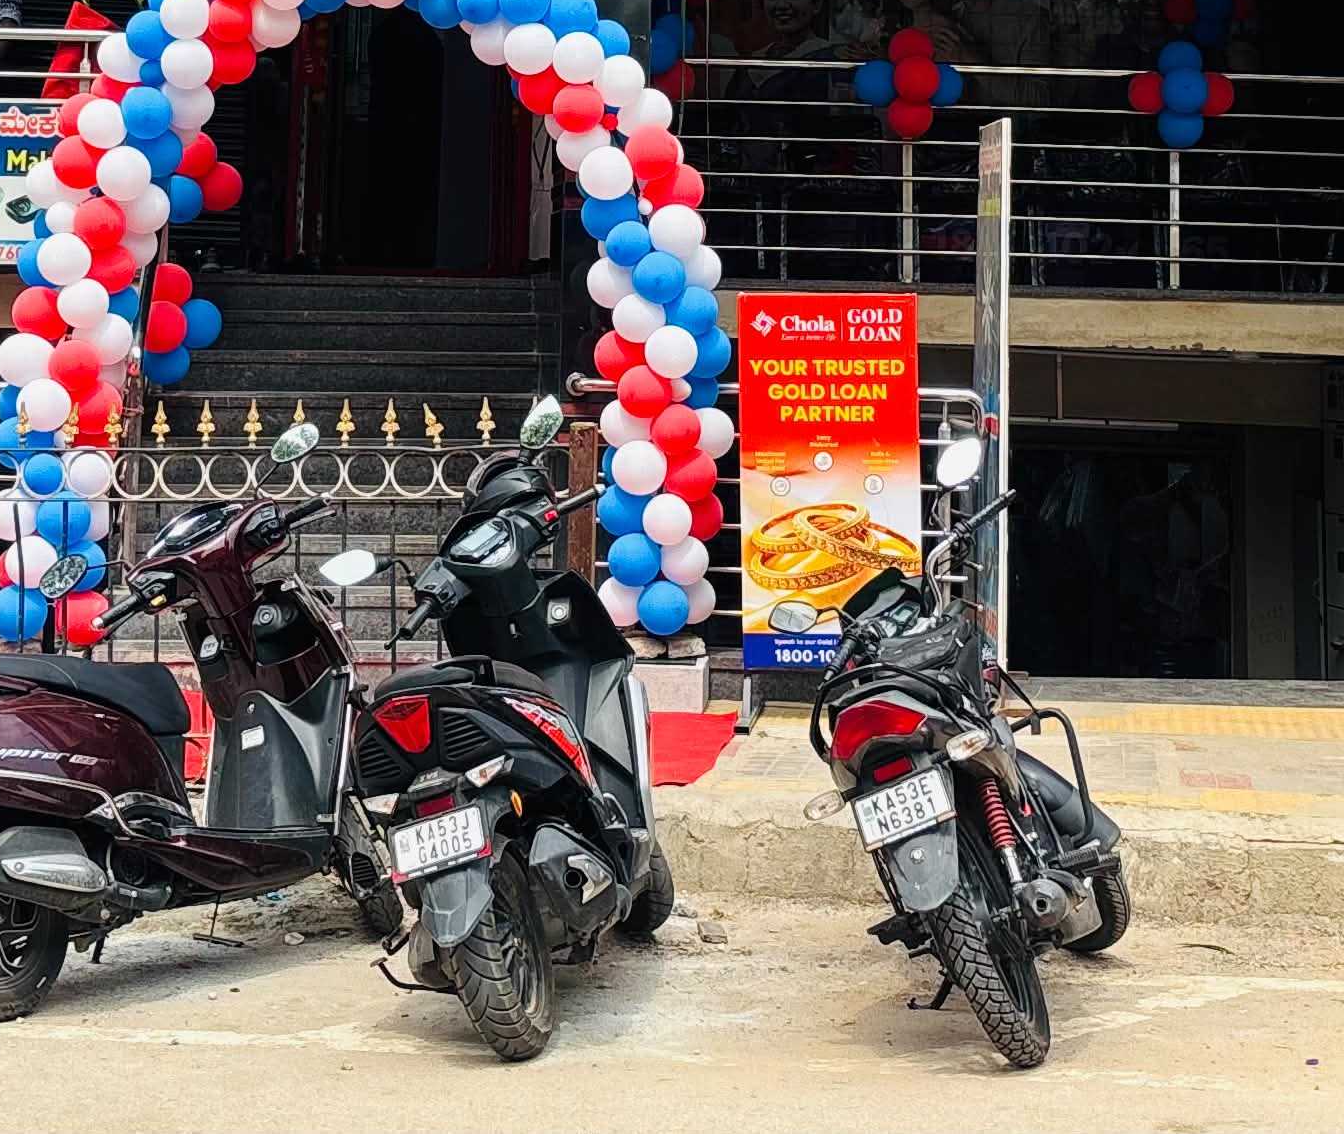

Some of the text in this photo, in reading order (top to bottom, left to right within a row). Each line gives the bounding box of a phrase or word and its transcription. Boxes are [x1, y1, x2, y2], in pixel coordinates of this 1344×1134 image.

[780, 315, 835, 332] Chola
[846, 307, 903, 324] GOLD
[848, 325, 902, 342] LOAN
[749, 359, 905, 377] YOUR TRUSTED
[767, 383, 887, 401] GOLD LOAN
[780, 404, 875, 423] PARTNER
[774, 648, 836, 663] 1800-10
[870, 775, 934, 815] KA53E
[415, 811, 470, 845] KA53J
[417, 831, 473, 864] G4005
